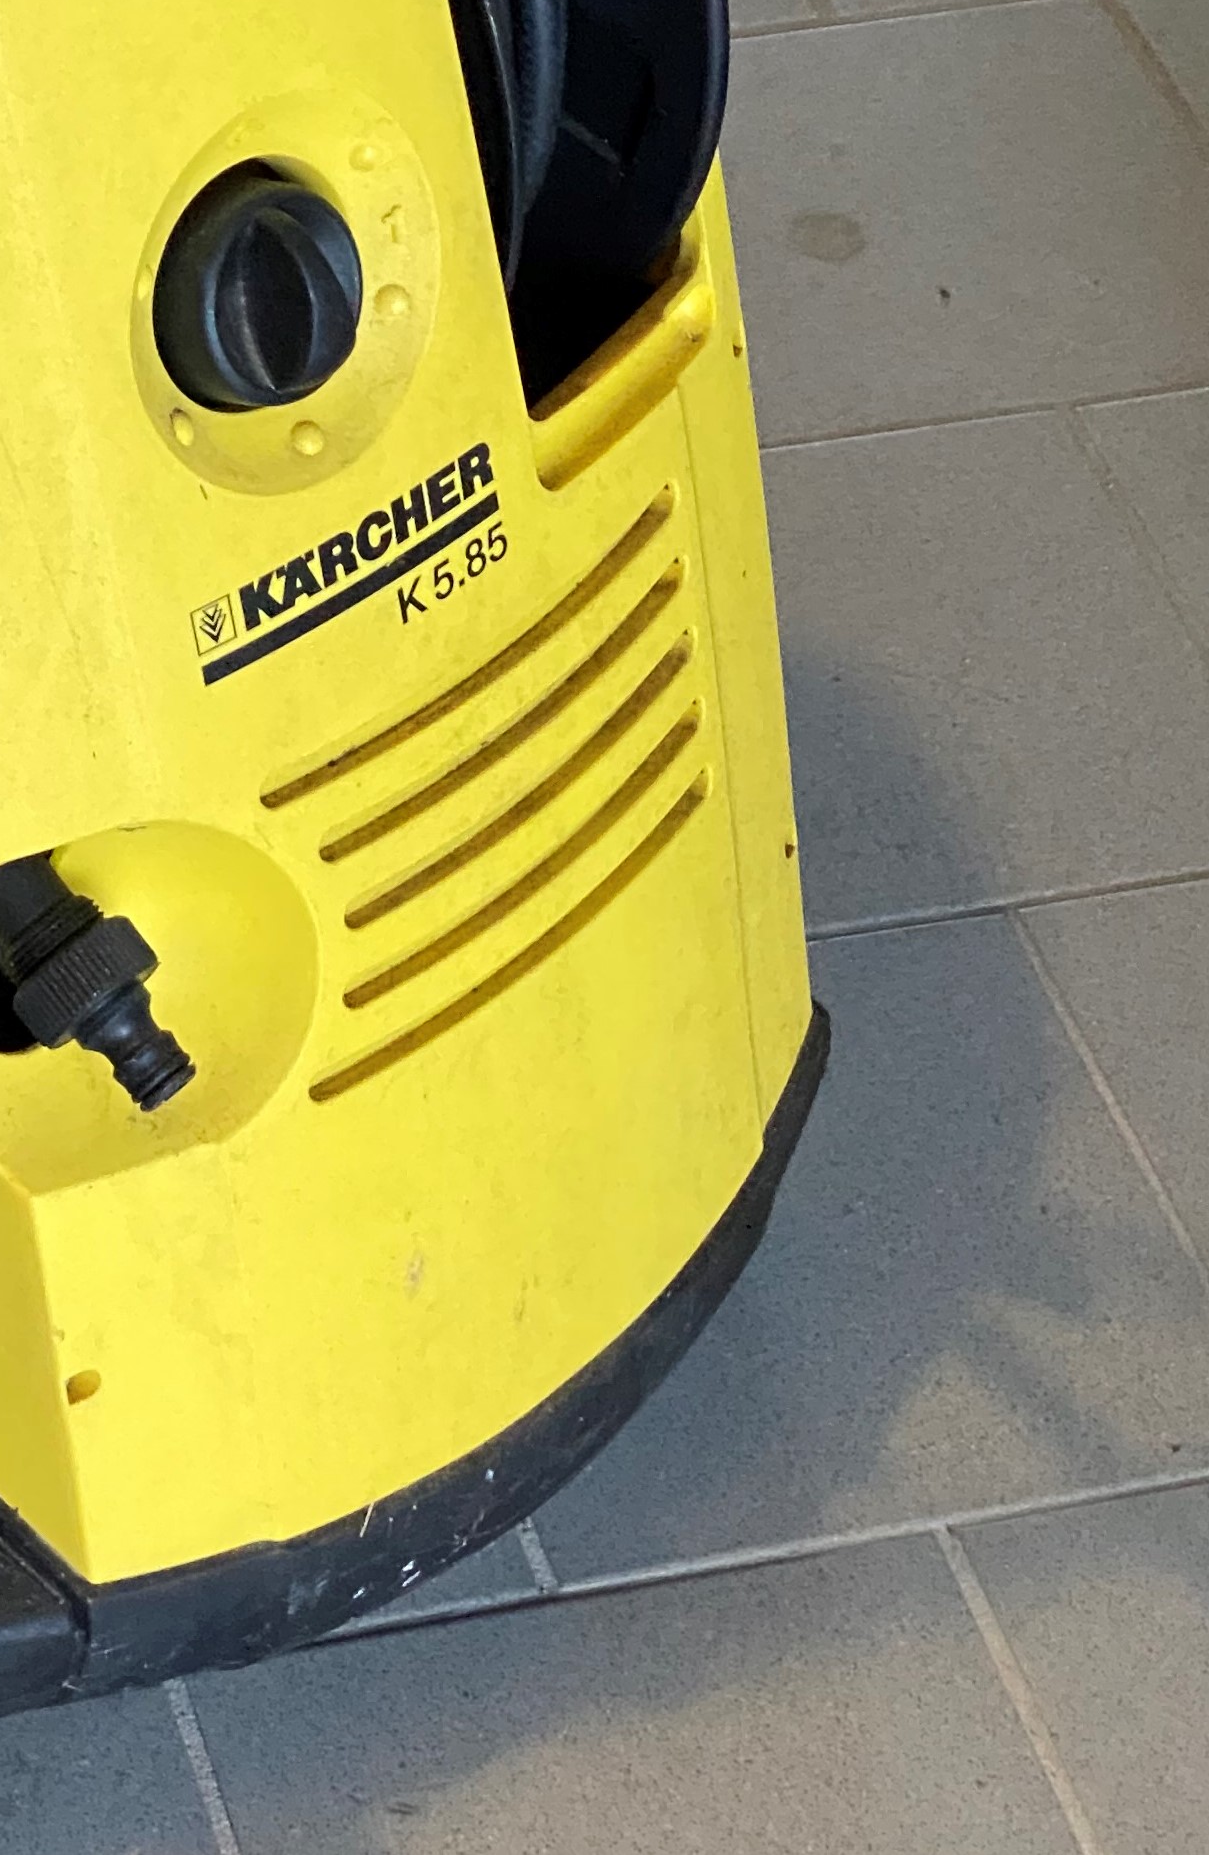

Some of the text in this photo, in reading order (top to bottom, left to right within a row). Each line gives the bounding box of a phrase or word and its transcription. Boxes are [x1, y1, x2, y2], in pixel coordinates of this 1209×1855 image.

[238, 442, 494, 632] KÄRCHER
[397, 520, 509, 625] K 5.85
